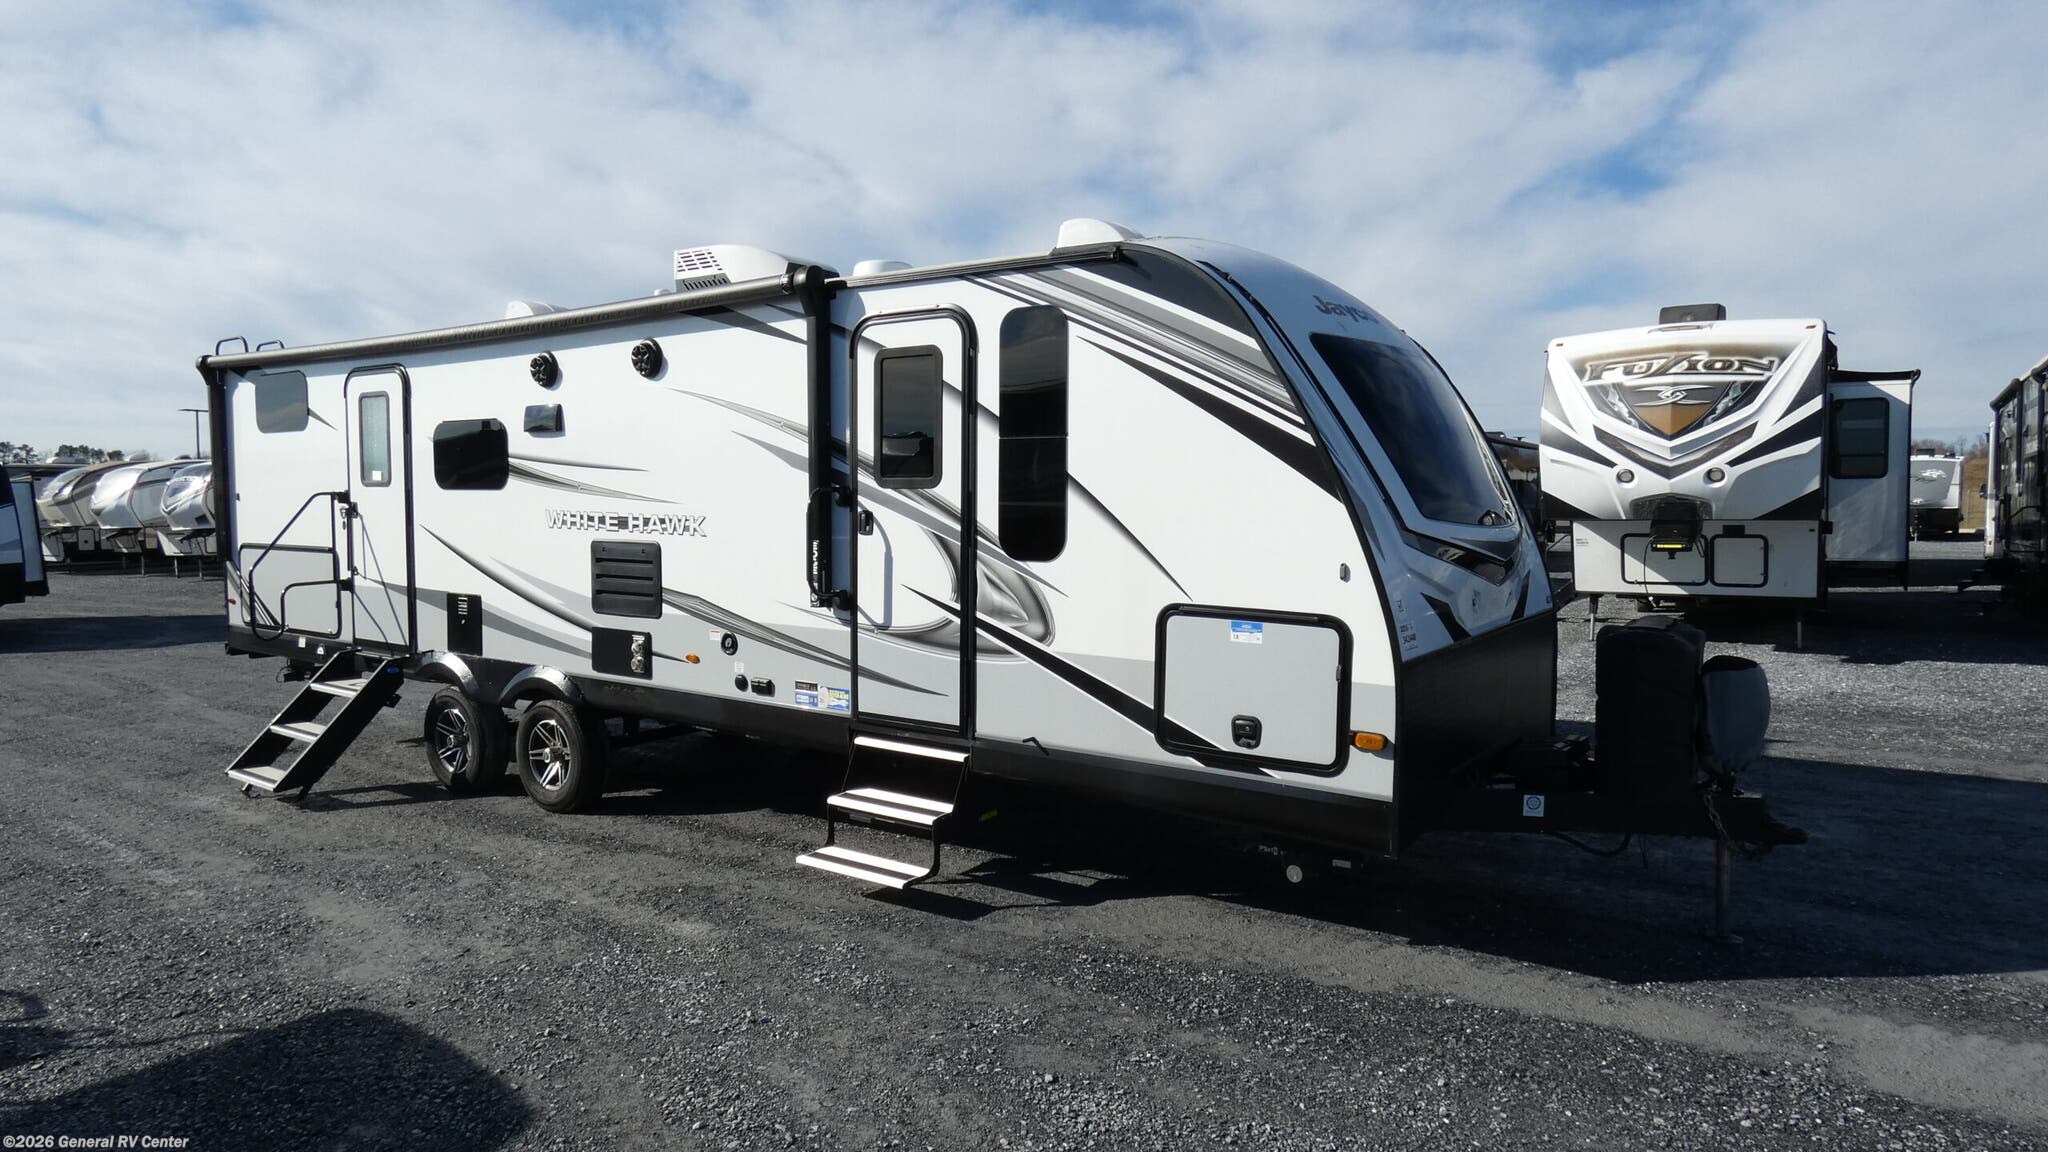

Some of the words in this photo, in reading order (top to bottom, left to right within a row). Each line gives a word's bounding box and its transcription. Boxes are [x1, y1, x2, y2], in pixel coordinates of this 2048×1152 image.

[1312, 294, 1379, 324] Jayco
[1584, 352, 1777, 383] FUZION
[545, 509, 620, 532] WHITE
[627, 513, 708, 537] HAWK
